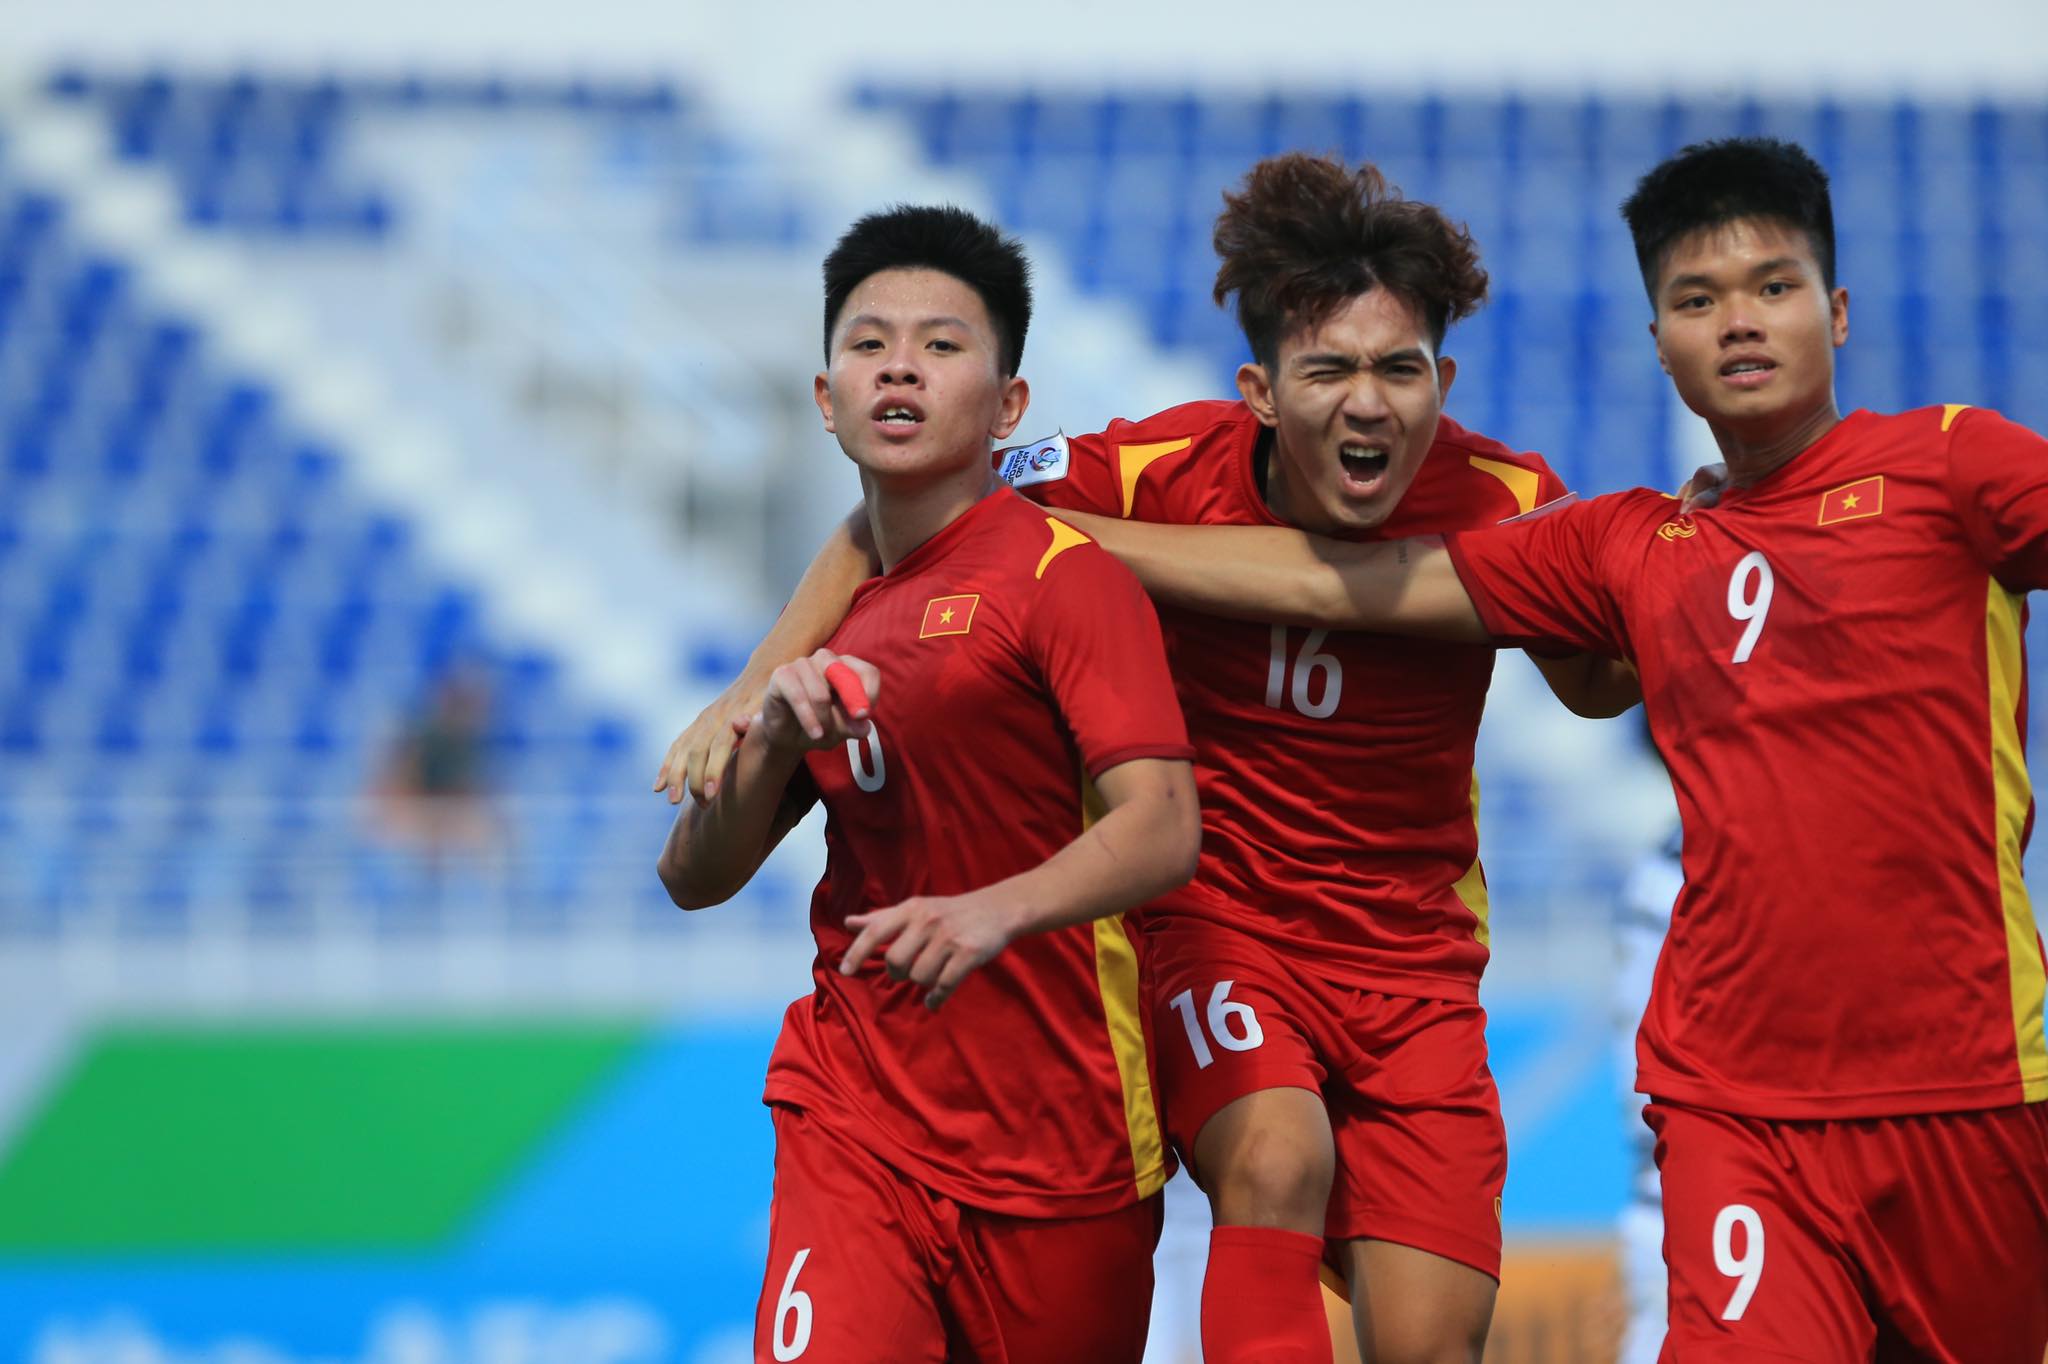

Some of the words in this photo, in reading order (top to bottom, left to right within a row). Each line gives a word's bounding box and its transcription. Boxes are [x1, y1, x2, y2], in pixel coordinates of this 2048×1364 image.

[1728, 551, 1774, 664] 9
[1265, 624, 1343, 719] 16
[1169, 980, 1264, 1070] 16
[773, 1247, 813, 1363] 6
[1712, 1204, 1765, 1321] 9
